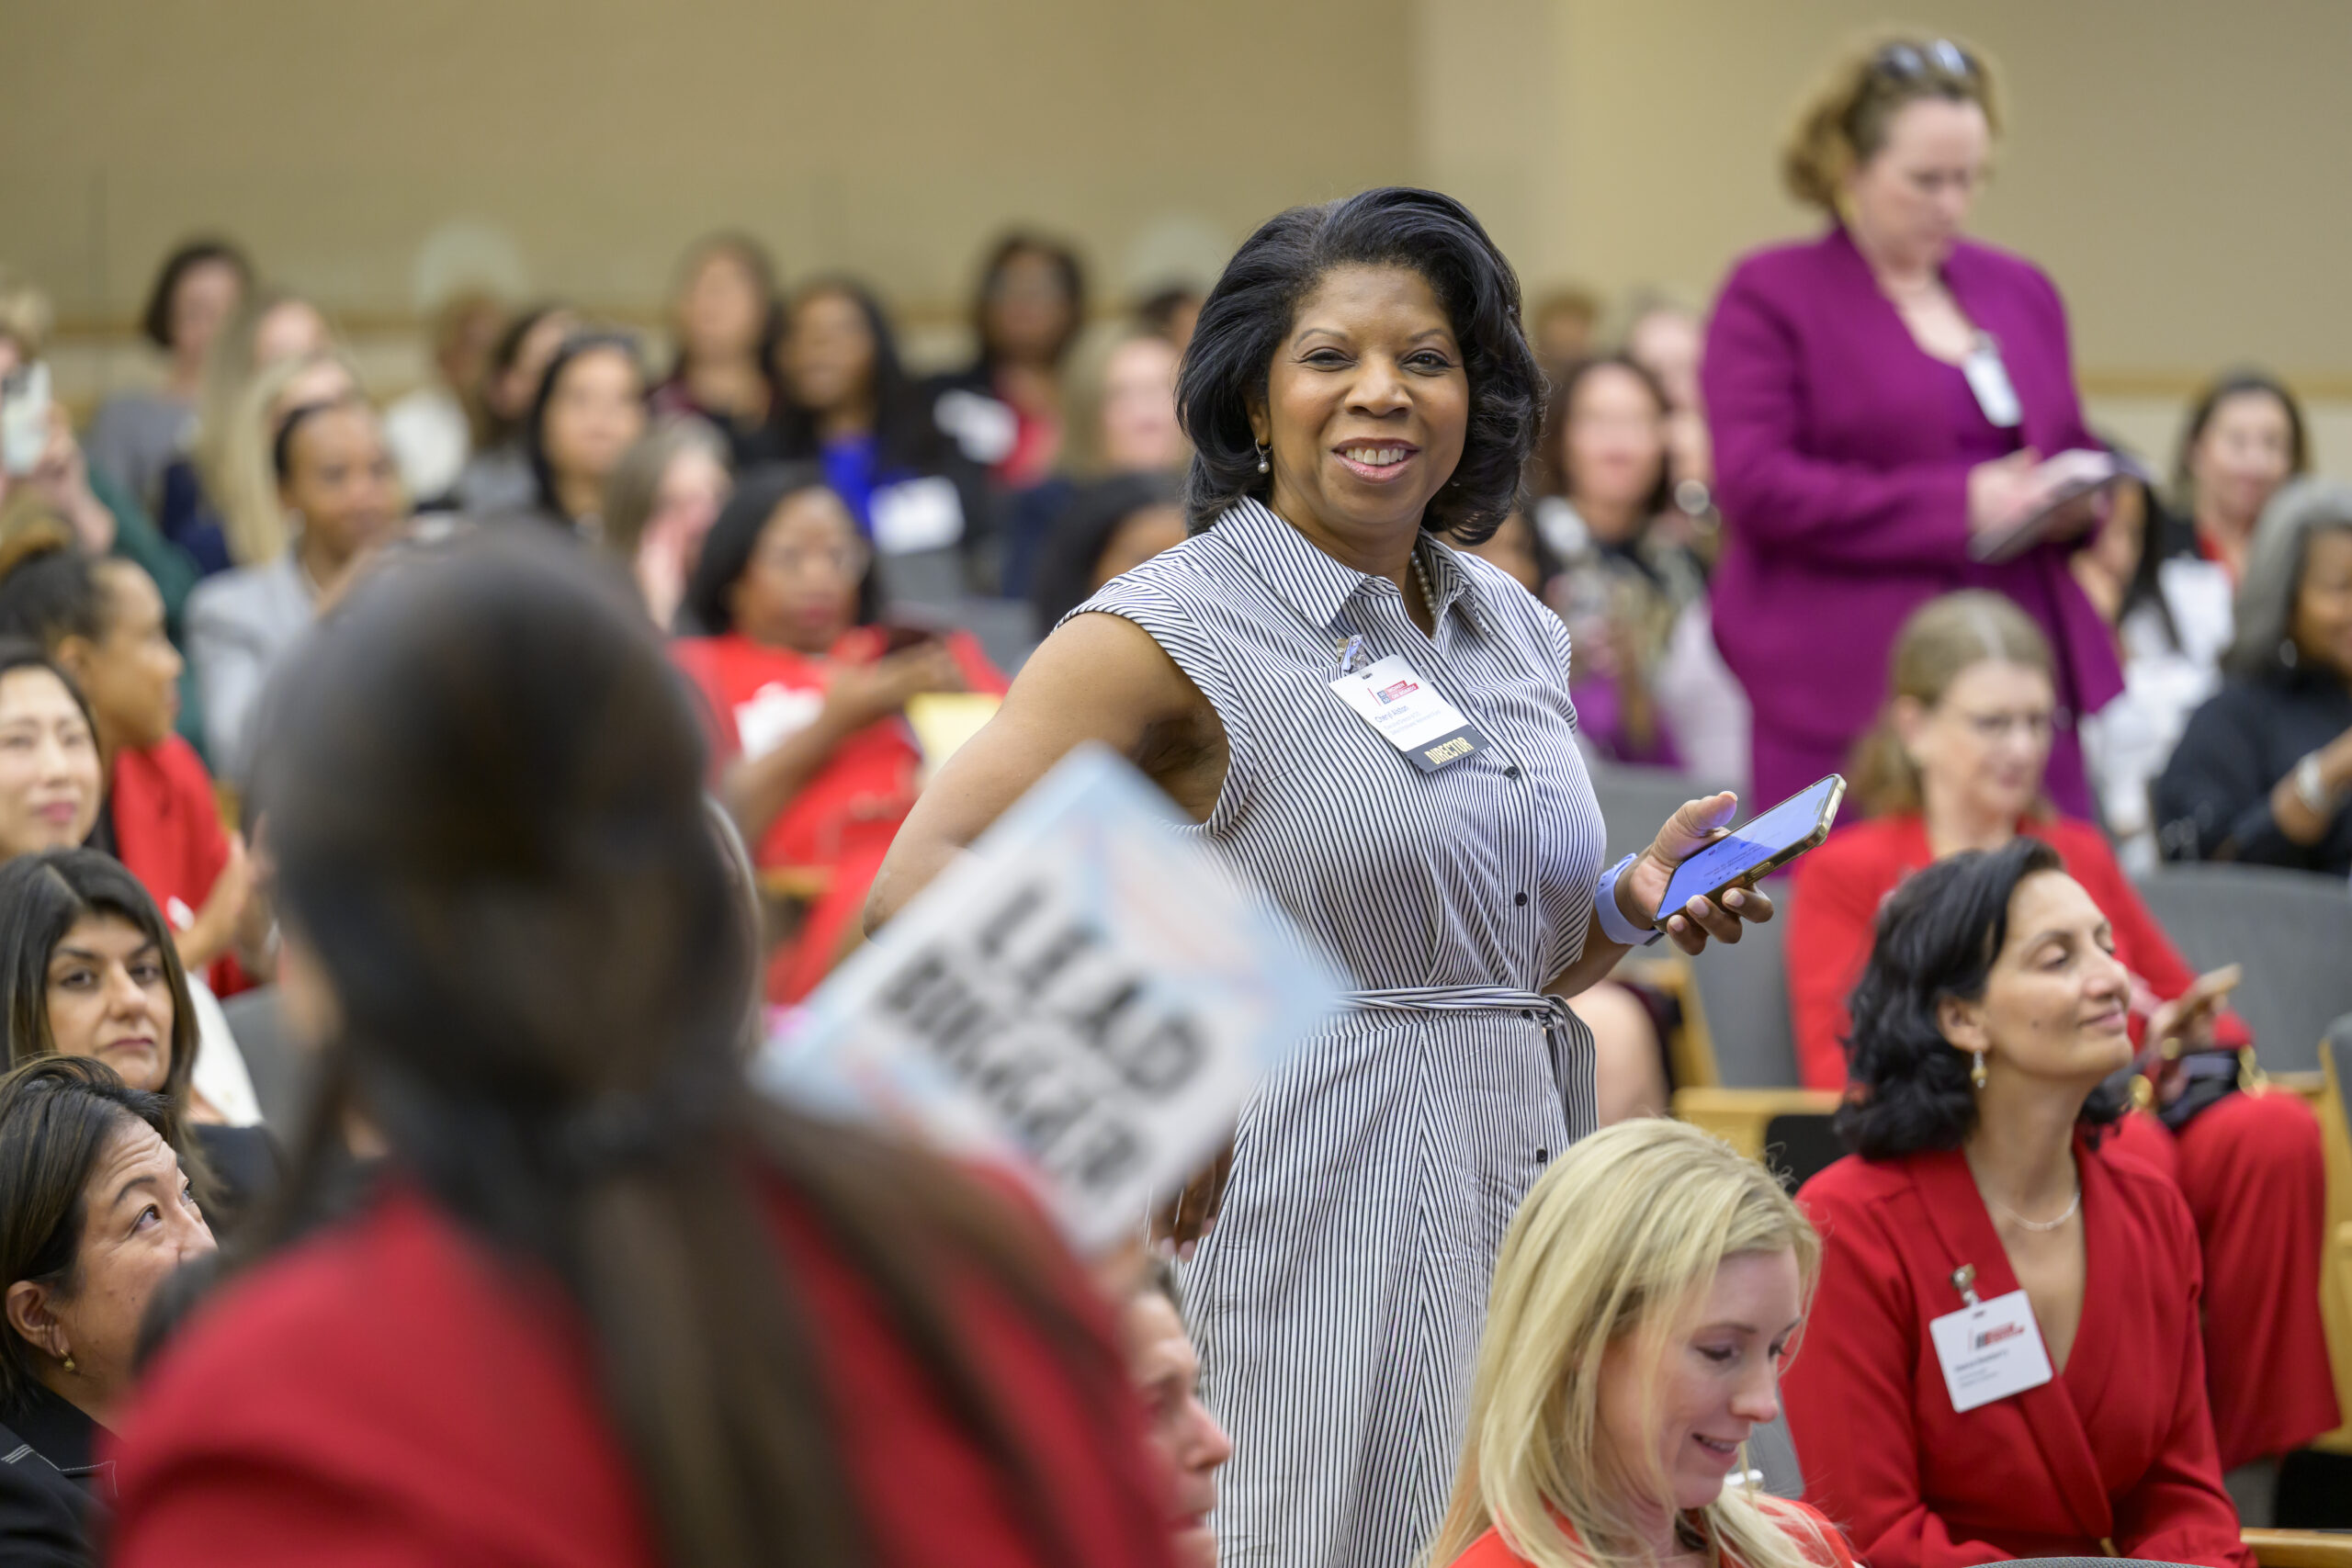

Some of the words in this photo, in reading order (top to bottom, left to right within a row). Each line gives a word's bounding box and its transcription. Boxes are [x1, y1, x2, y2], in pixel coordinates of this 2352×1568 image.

[1424, 737, 1475, 765] DIRECTOR
[871, 944, 1152, 1190] BIGGER
[976, 877, 1209, 1096] LEAD
